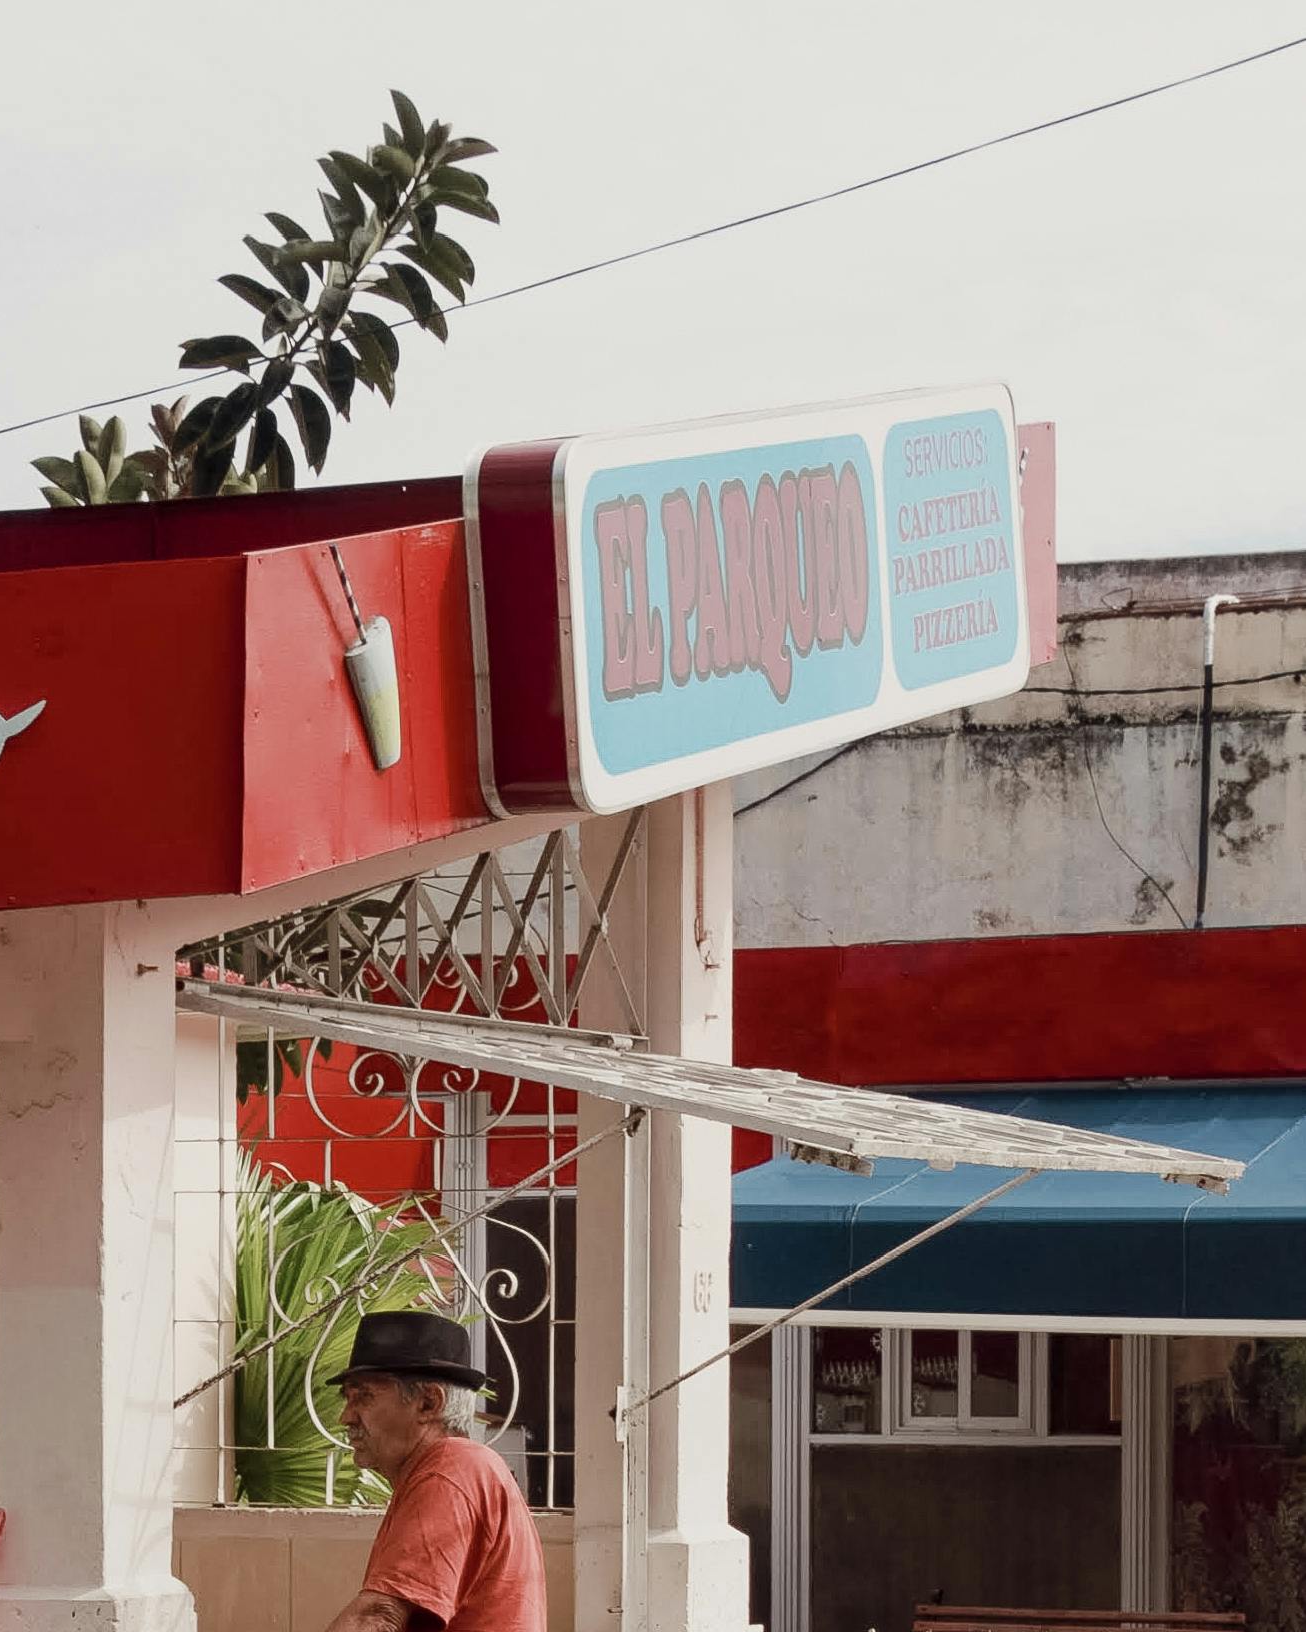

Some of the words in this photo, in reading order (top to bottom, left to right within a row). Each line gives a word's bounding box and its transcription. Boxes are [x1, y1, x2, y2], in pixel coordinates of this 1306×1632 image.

[903, 427, 988, 478] SERVICIOS:
[897, 479, 1002, 542] CAFETERÍA
[594, 494, 664, 702] EL
[661, 460, 869, 704] PARQUEO
[893, 535, 1011, 596] PARRILLADA
[912, 589, 998, 654] PIZZERÍA
